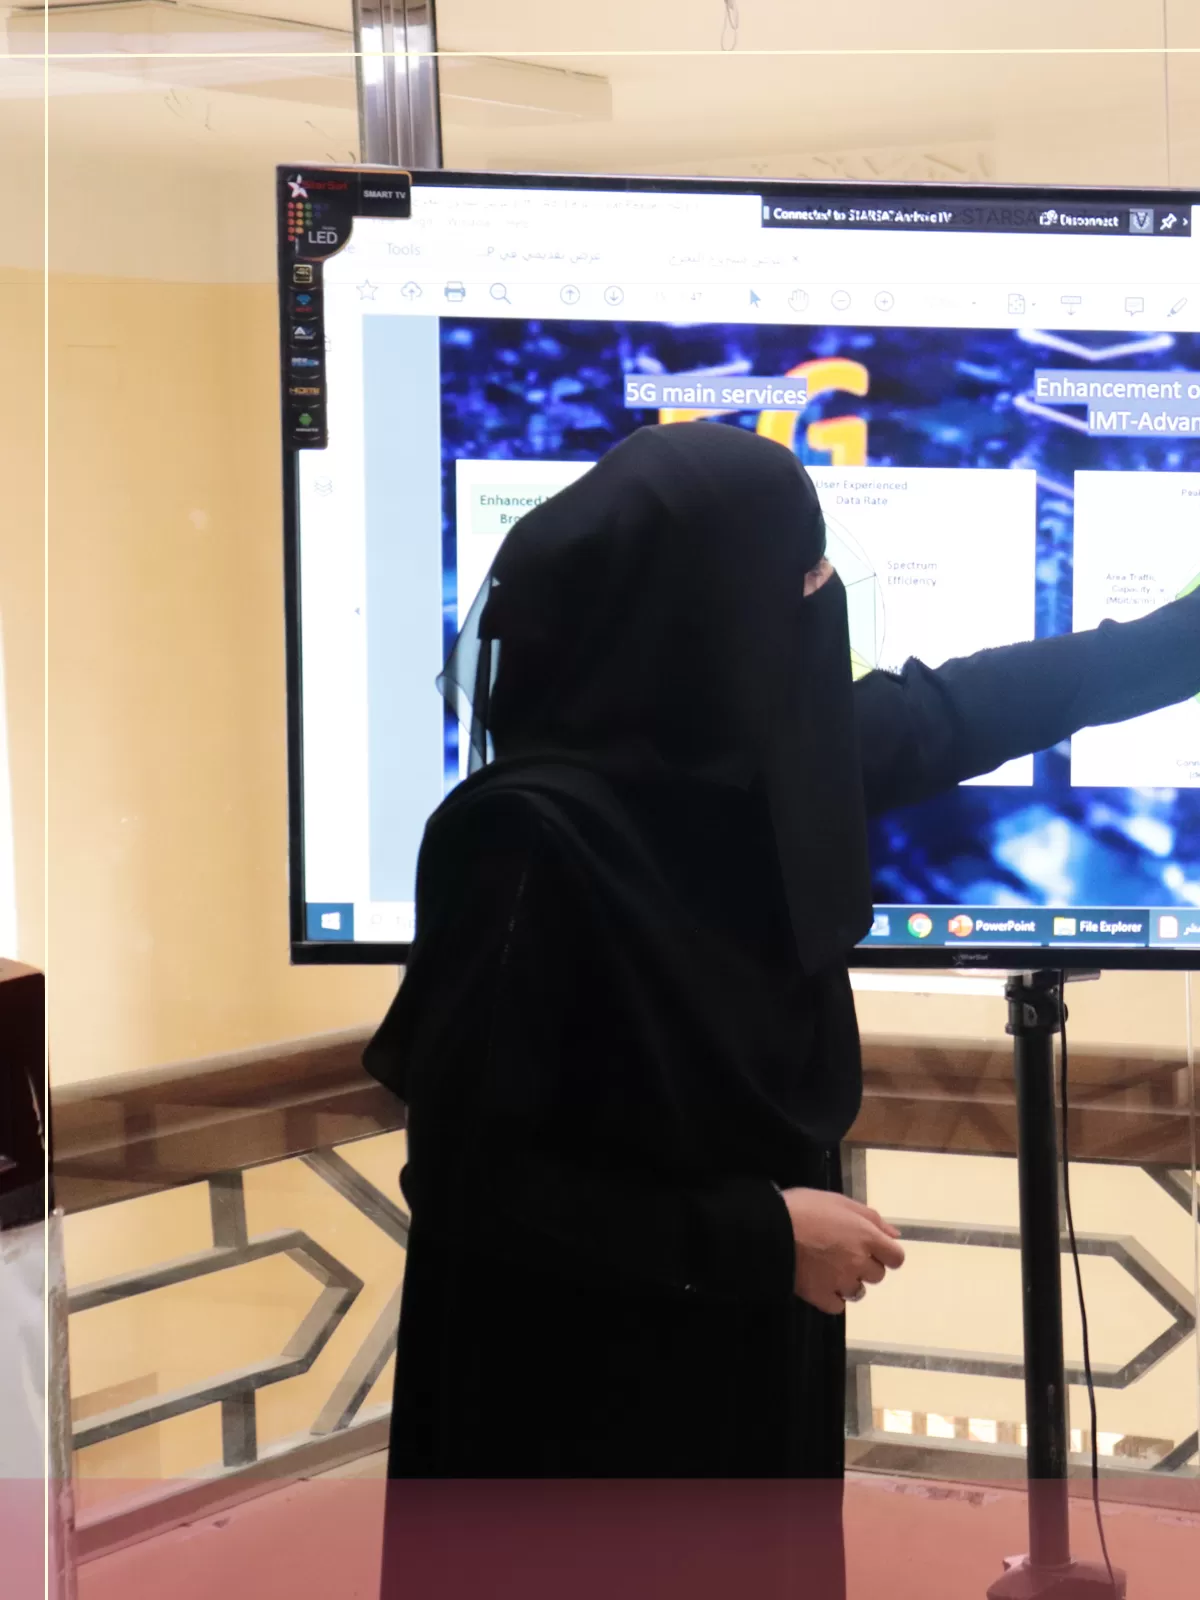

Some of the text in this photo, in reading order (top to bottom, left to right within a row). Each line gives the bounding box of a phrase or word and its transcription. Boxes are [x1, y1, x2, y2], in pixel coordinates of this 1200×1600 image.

[363, 190, 393, 198] SMART
[308, 231, 338, 244] LED
[387, 243, 421, 256] Tools
[626, 383, 806, 404] 5G main services
[1036, 378, 1183, 399] Enhancement
[842, 480, 909, 493] Experienced
[479, 494, 543, 508] Enhanced
[836, 495, 889, 506] Data Rate
[887, 560, 938, 572] Spectrum
[886, 575, 938, 588] Efficiency
[976, 920, 1035, 933] PowerPoint
[1079, 920, 1141, 934] File Explorer
